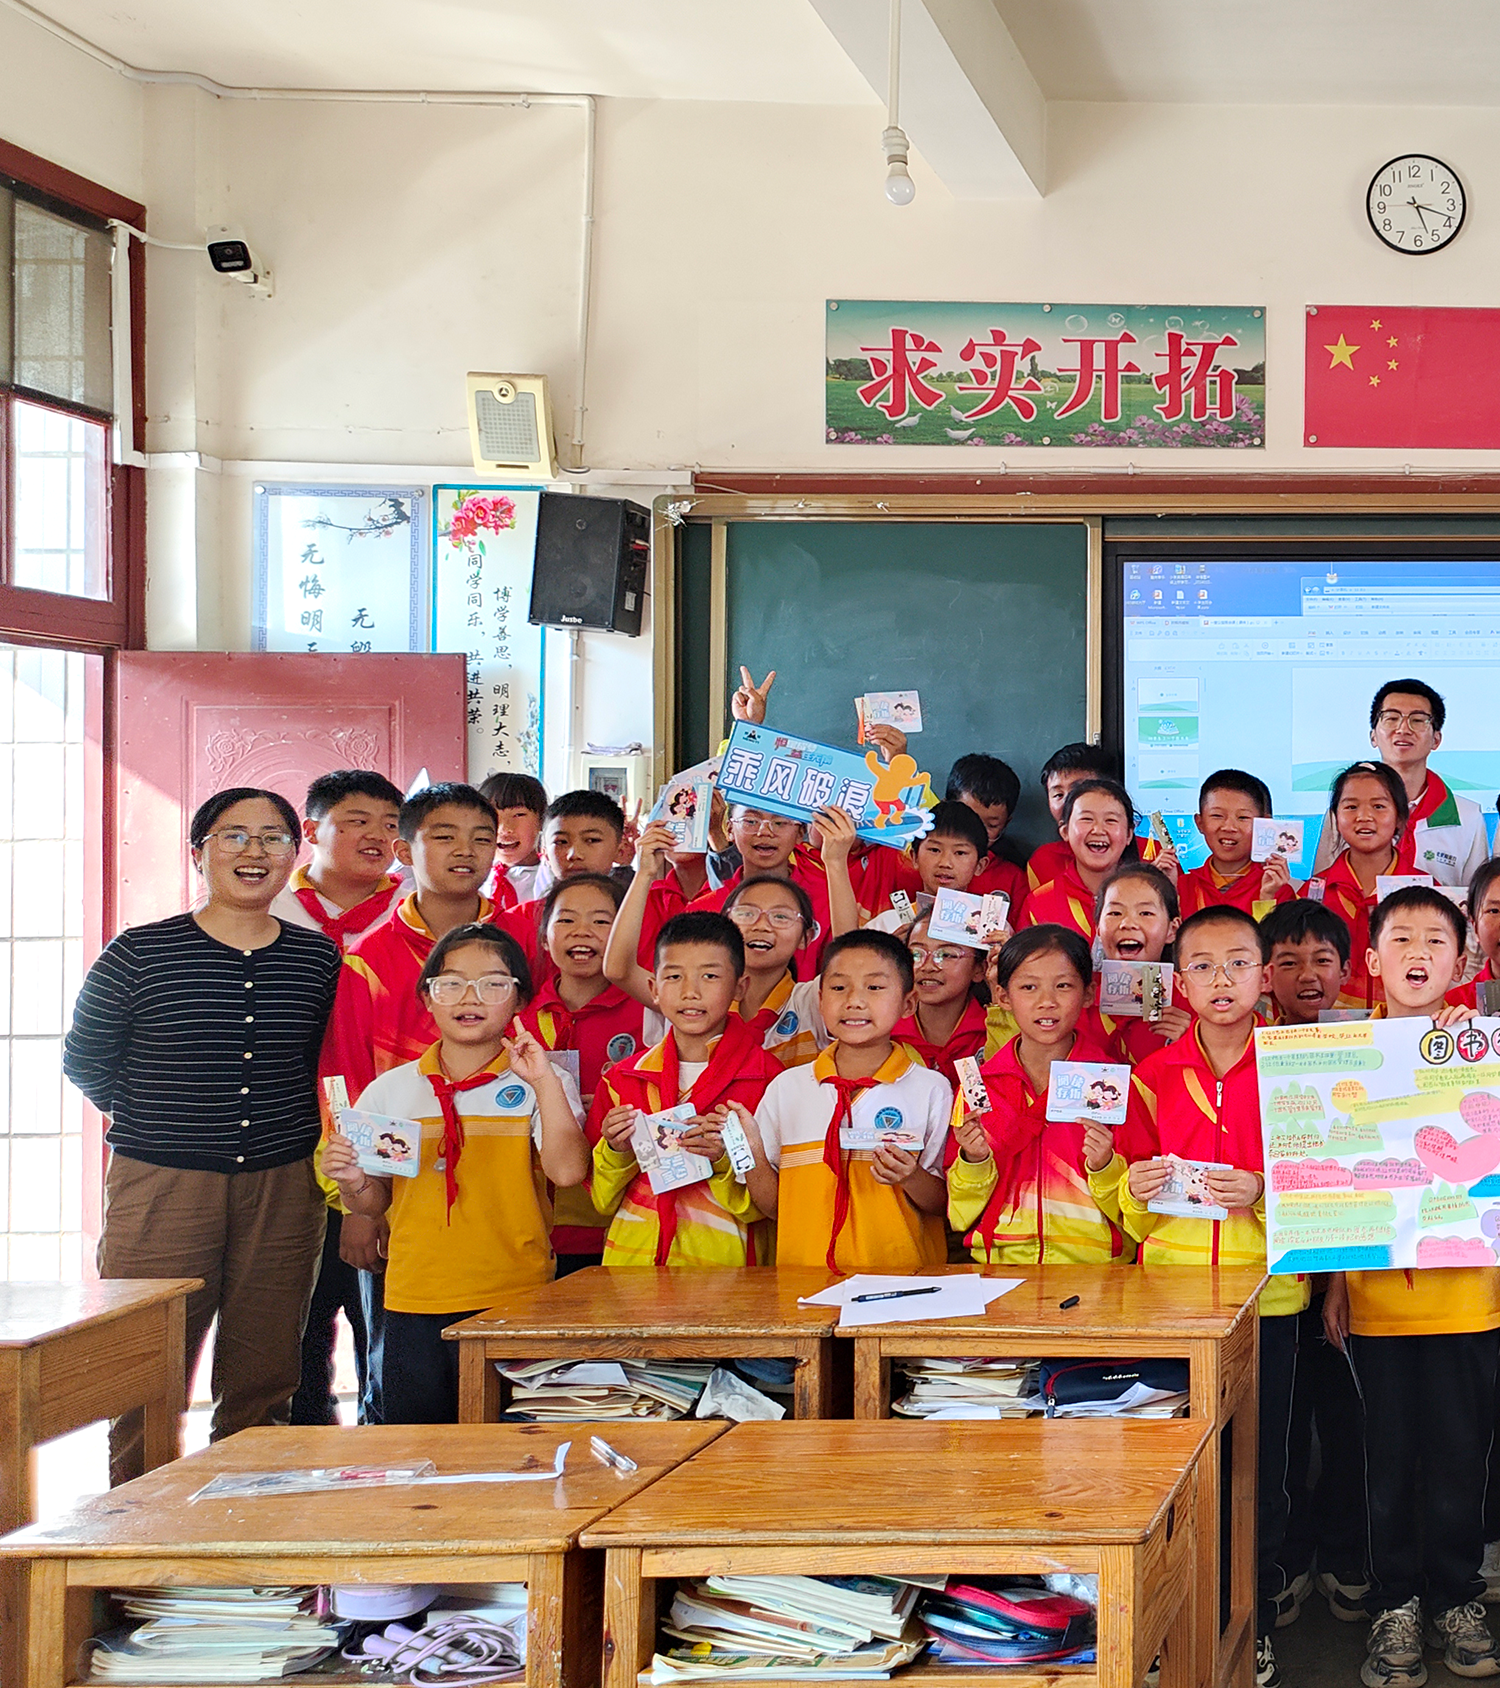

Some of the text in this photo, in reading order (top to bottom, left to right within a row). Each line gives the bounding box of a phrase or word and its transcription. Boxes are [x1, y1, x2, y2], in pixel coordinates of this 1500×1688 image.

[1392, 170, 1402, 183] 11
[1408, 165, 1421, 178] 12
[1379, 184, 1392, 197] 10
[1440, 181, 1450, 194] 2
[1377, 201, 1386, 214] 9
[1446, 198, 1456, 211] 3
[1383, 218, 1392, 231] 8
[1443, 216, 1452, 228] 4
[1396, 231, 1405, 243] 7
[1414, 235, 1423, 247] 6
[1431, 229, 1440, 242] 5
[857, 327, 1240, 422] 求实开拓
[724, 746, 873, 822] 乘风破浪
